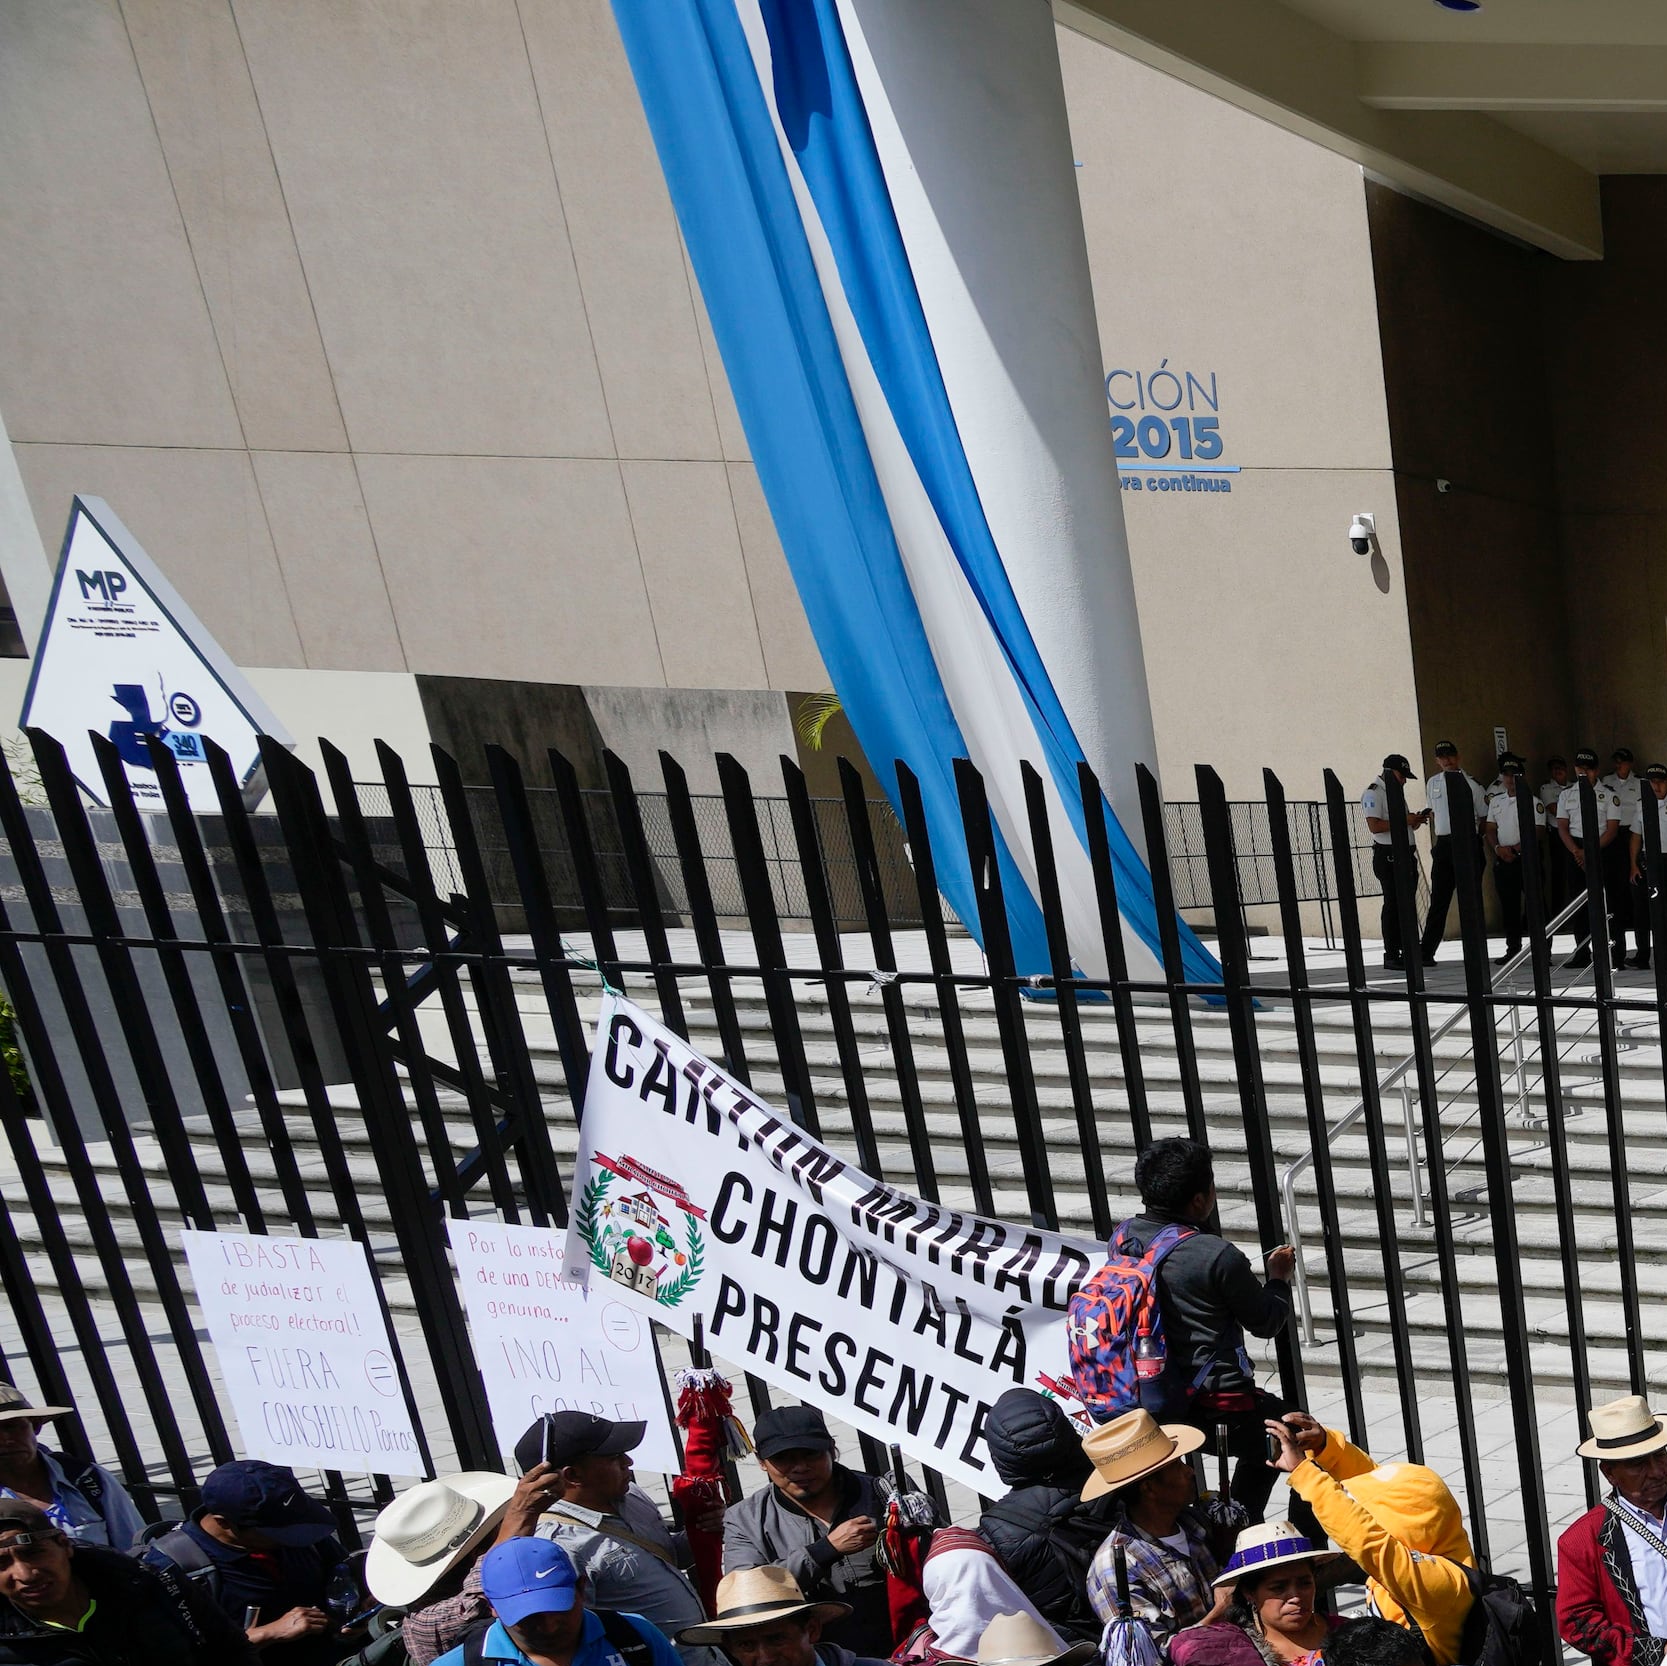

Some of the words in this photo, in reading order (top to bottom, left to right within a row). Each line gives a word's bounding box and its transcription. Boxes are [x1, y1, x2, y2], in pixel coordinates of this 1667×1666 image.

[1110, 415, 1223, 460] 2015
[1146, 474, 1232, 493] continua
[75, 569, 127, 601] MP
[468, 1231, 496, 1254] Por
[221, 1281, 238, 1296] de
[336, 1283, 350, 1304] el
[477, 1266, 498, 1286] de
[503, 1271, 529, 1288] una
[711, 1171, 1028, 1385] CHONTALÁ
[230, 1312, 280, 1333] proceso
[246, 1346, 341, 1390] FUERA
[581, 1347, 621, 1388] AL
[710, 1274, 992, 1472] PRESENTE
[263, 1401, 370, 1454] CONSUELO
[369, 1409, 418, 1455] Porras
